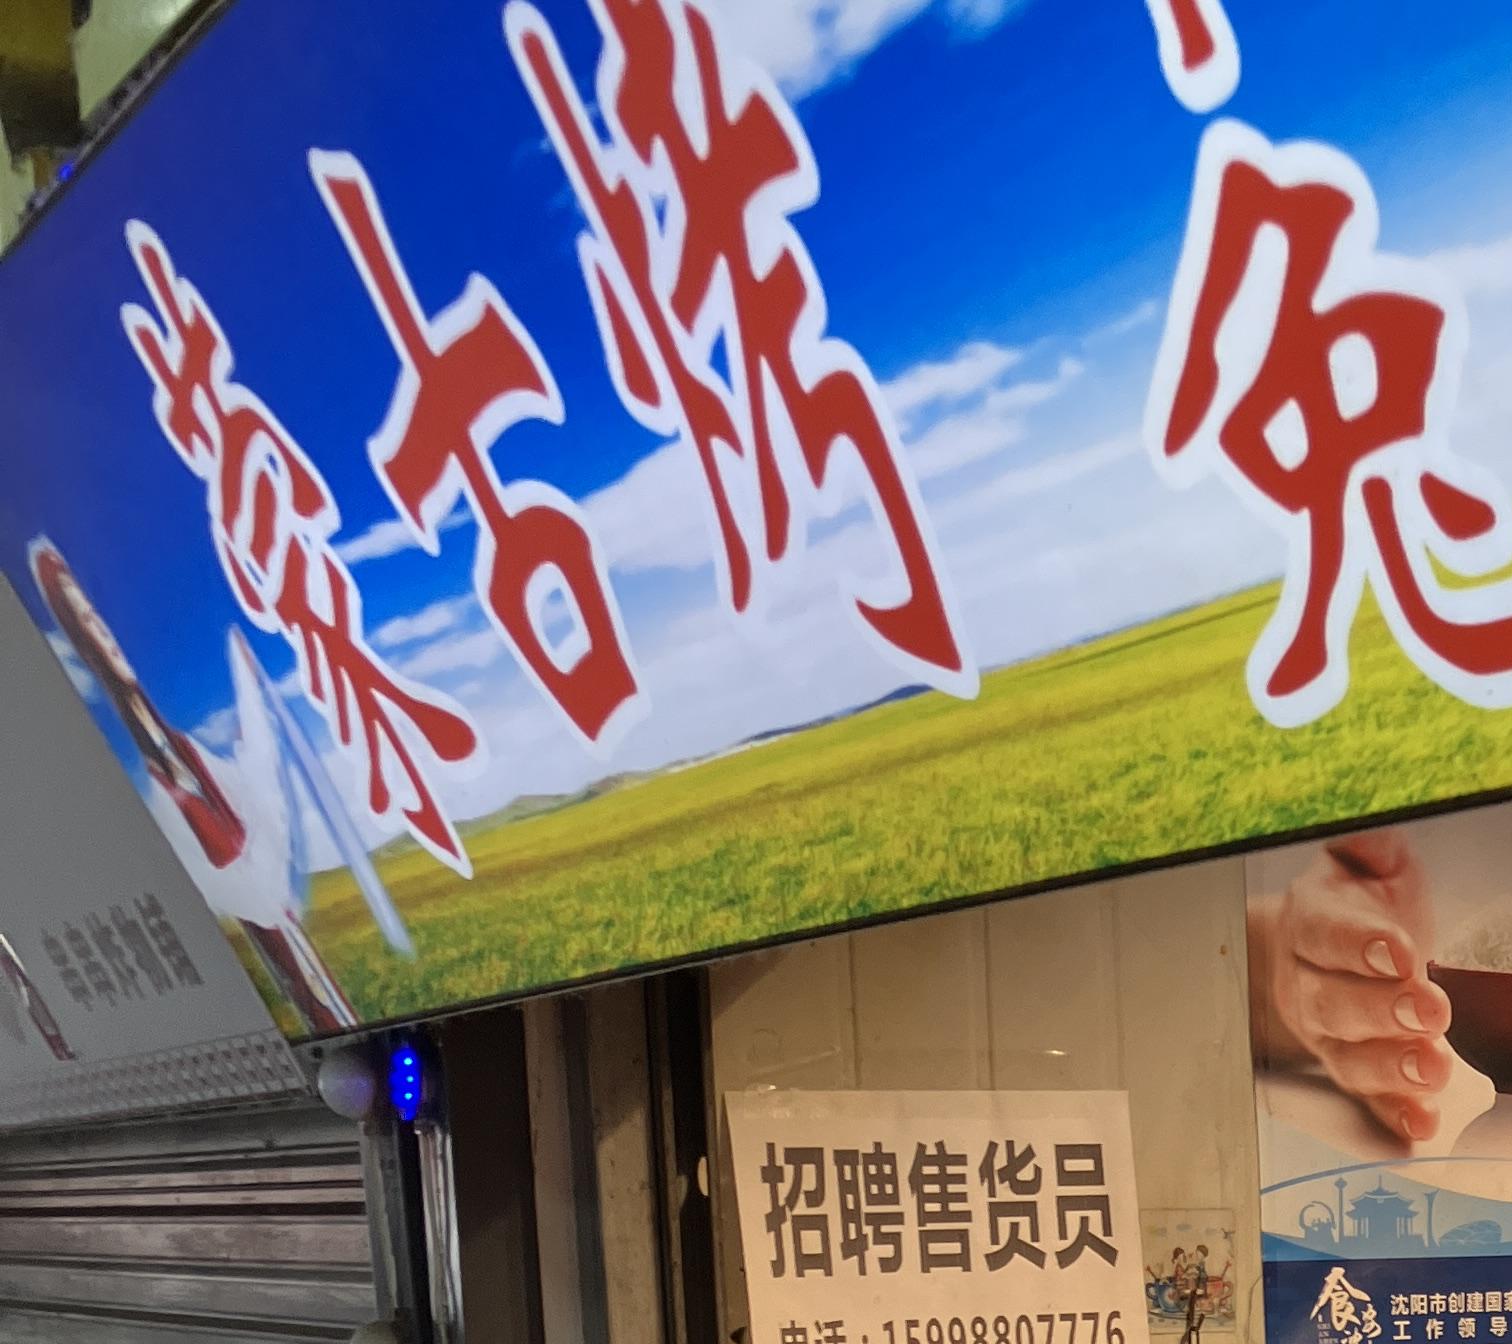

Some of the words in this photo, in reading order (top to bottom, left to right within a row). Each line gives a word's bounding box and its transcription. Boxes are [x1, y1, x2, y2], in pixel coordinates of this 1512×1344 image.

[761, 1139, 1119, 1278] 招聘售货员
